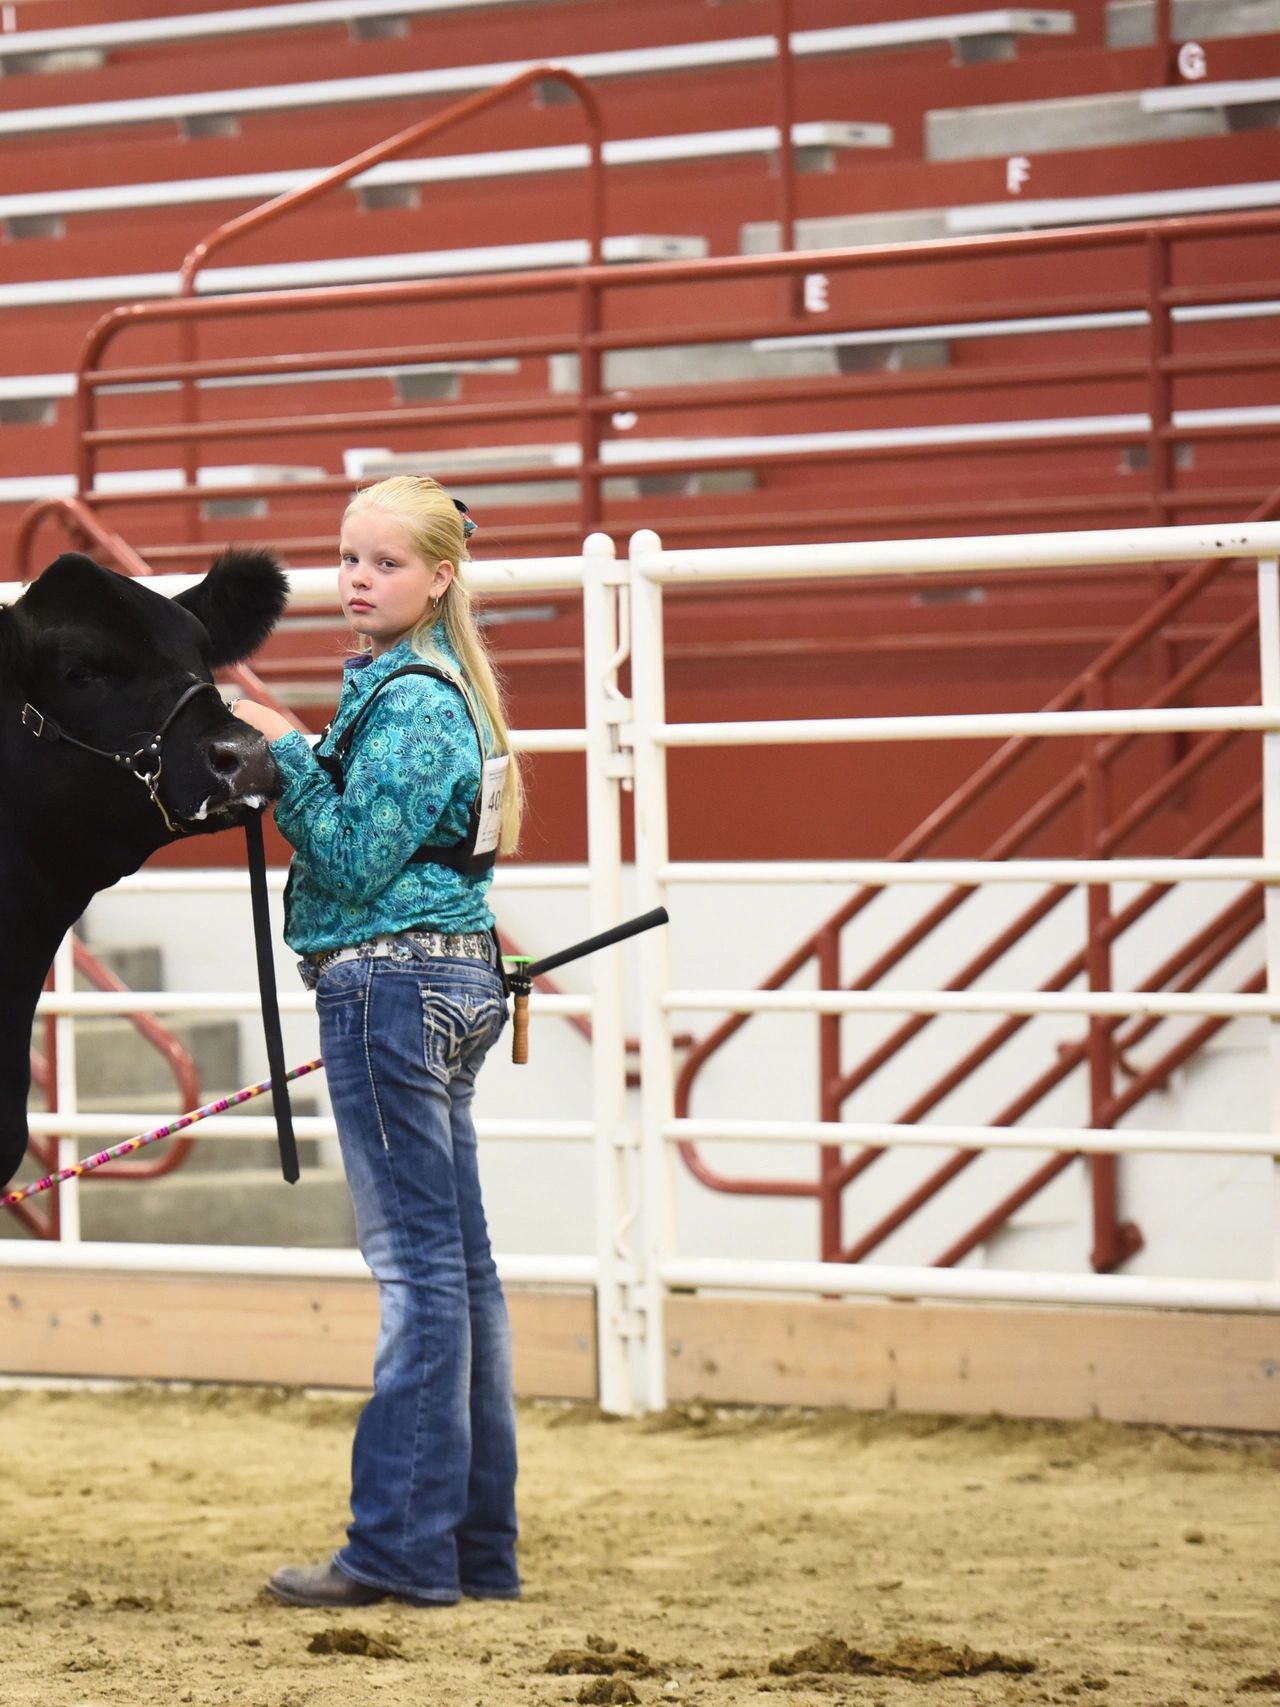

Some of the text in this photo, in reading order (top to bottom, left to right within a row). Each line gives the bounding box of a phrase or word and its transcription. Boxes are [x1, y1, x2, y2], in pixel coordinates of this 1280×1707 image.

[1179, 43, 1205, 80] G
[1006, 154, 1031, 193] F
[805, 273, 829, 312] E
